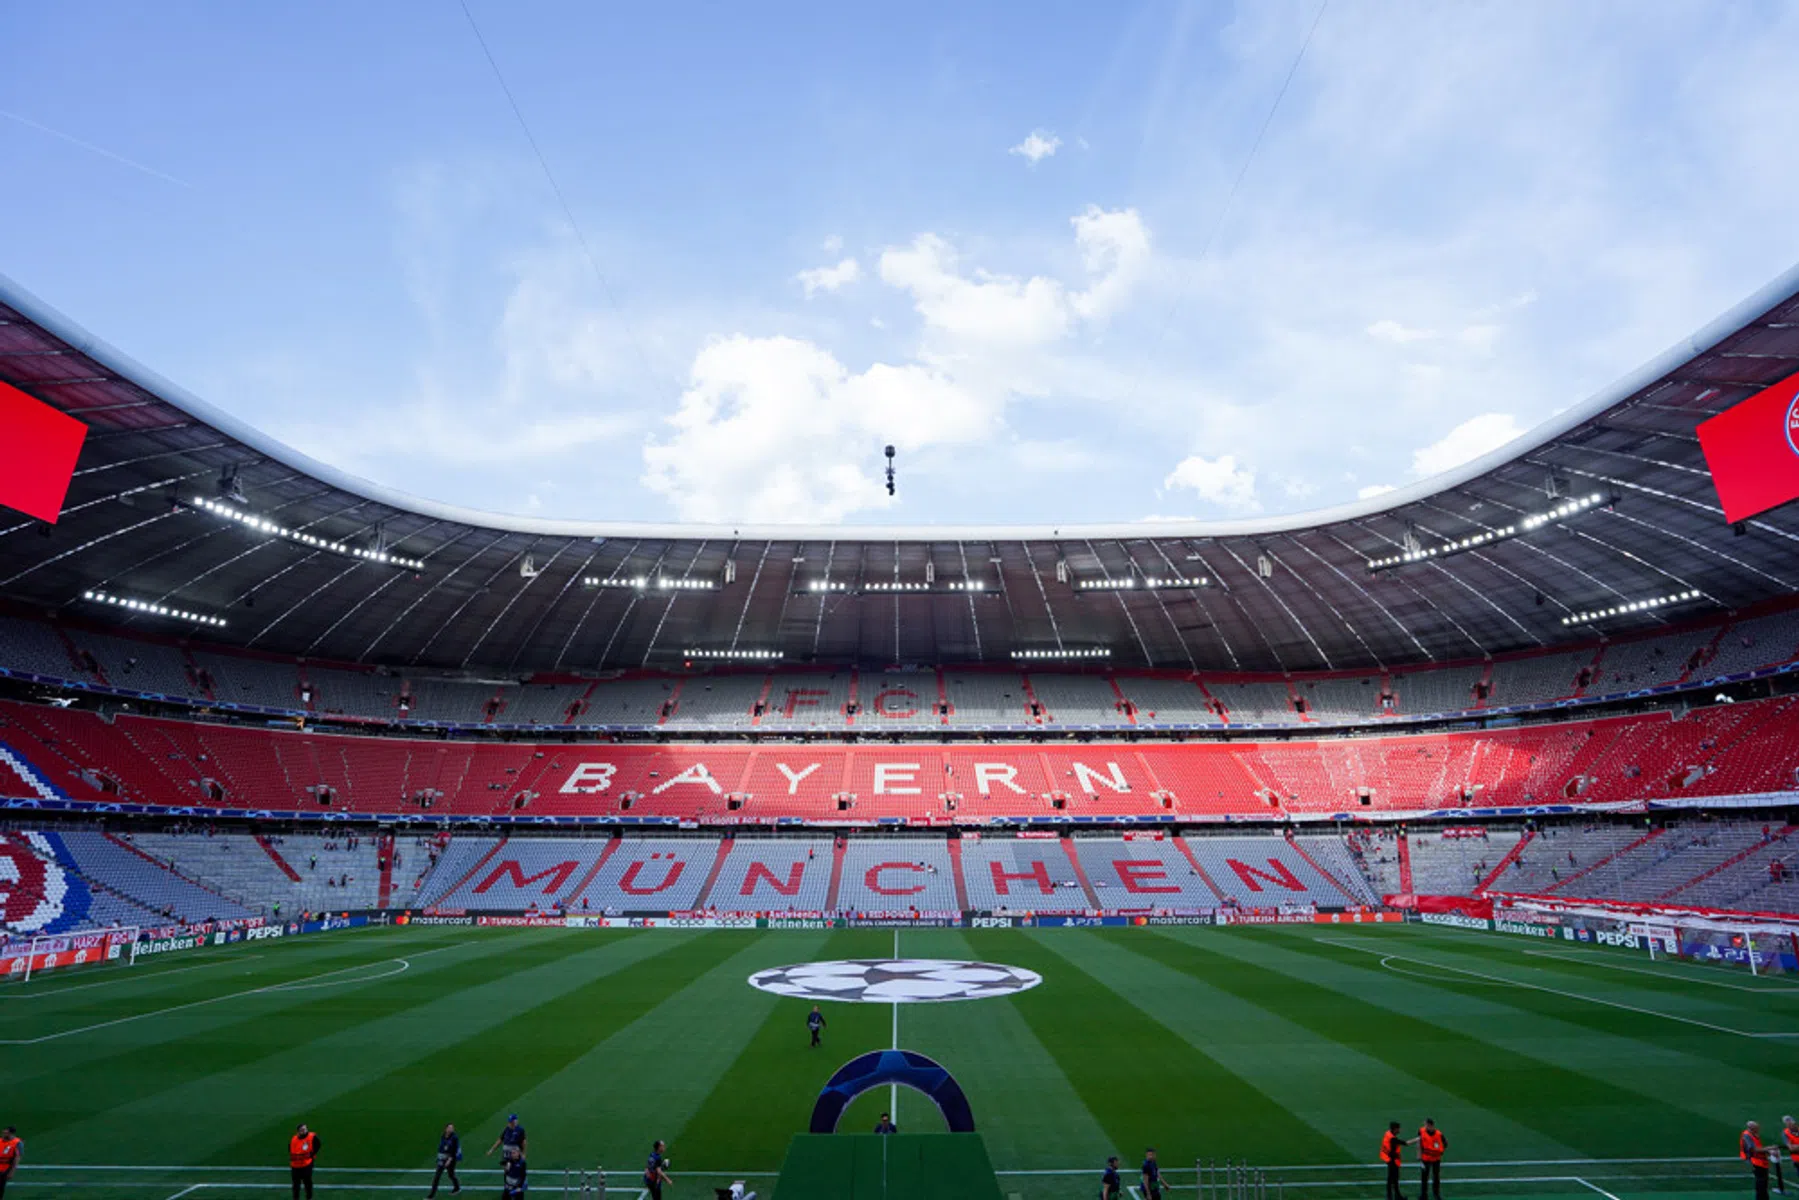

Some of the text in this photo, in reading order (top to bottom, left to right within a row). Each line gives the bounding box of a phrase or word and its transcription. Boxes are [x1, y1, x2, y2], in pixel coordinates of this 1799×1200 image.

[783, 689, 918, 718] FC
[559, 762, 1131, 794] BAYERN
[472, 852, 1308, 895] MÜNCHEN
[412, 916, 472, 925] mastercard
[492, 916, 567, 926] TURKISH AIRLINES
[584, 918, 610, 927] FedEx
[628, 918, 655, 927] FedEx
[670, 918, 707, 928] oppo
[715, 918, 751, 928] oppo
[768, 918, 824, 928] Heineken
[972, 918, 1012, 928] PEPSI
[1076, 918, 1102, 926] PS5
[1150, 916, 1211, 925] mastercard
[1239, 915, 1314, 924] TURKISH AIRLINES
[246, 925, 284, 940] PEPSI
[1494, 920, 1546, 936] Heineken
[1596, 931, 1640, 949] PEPSI
